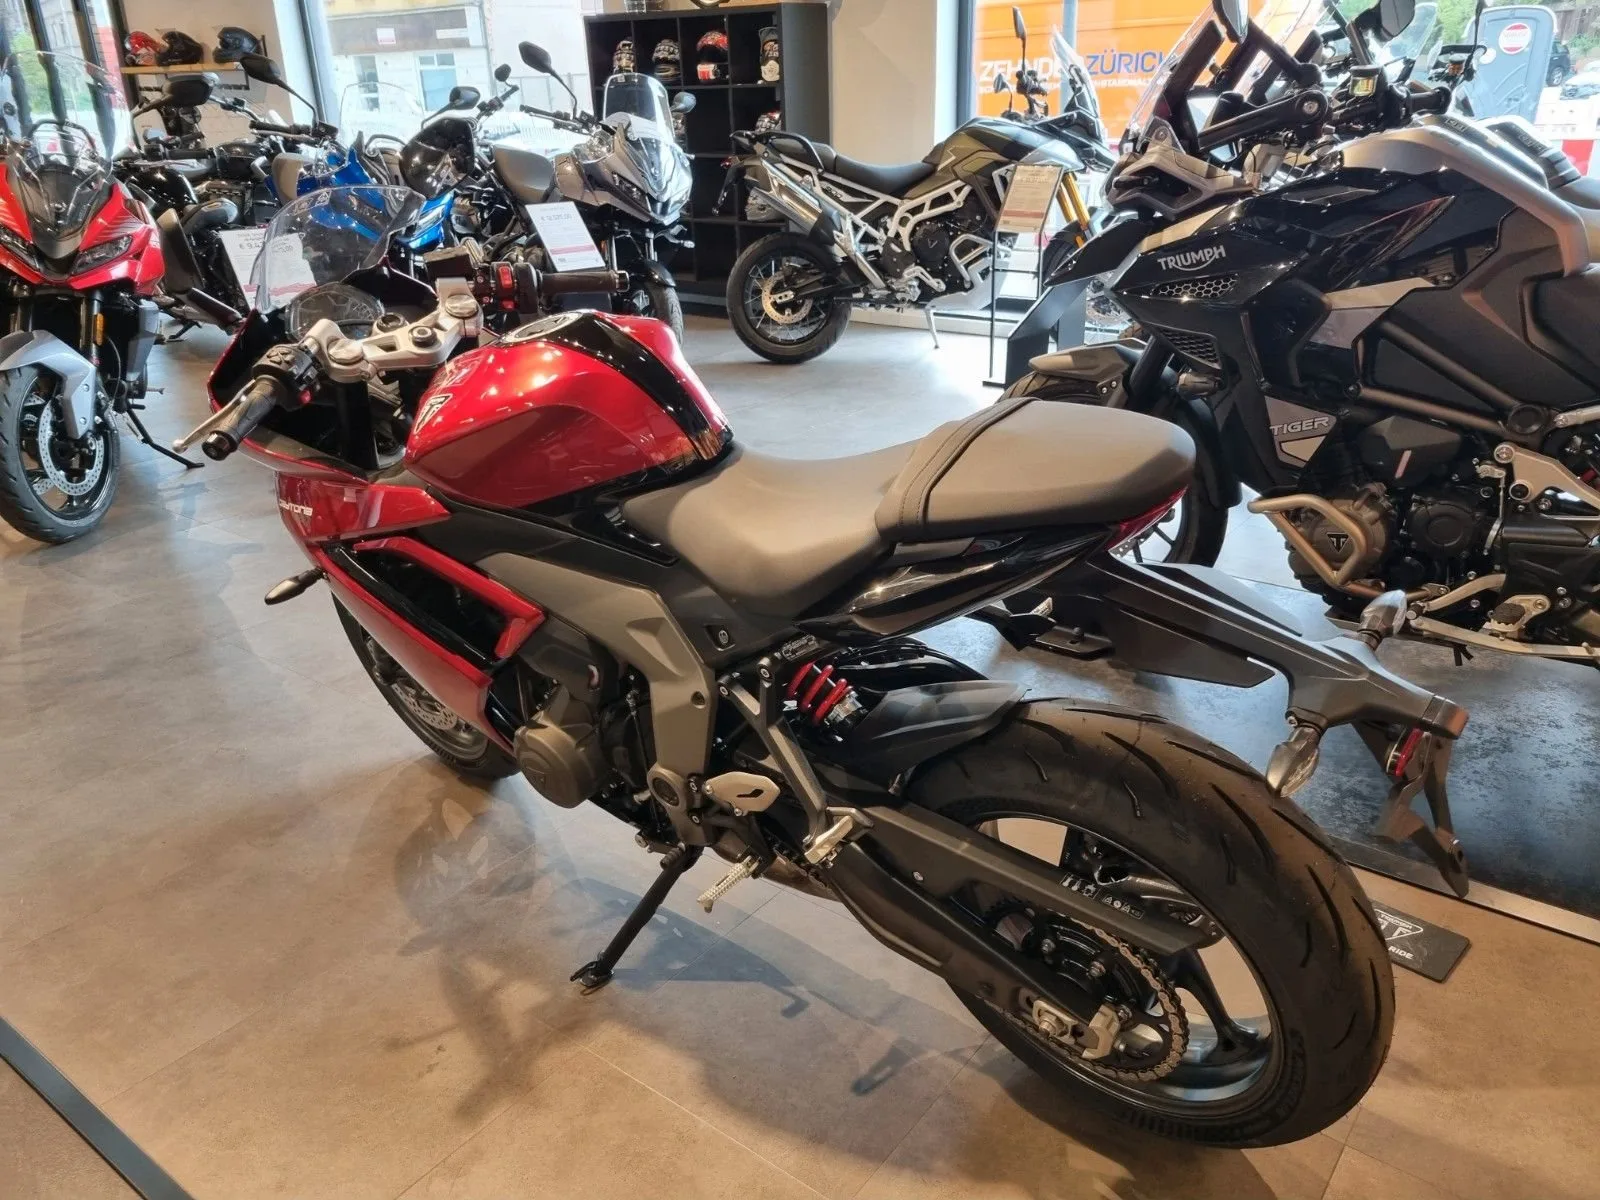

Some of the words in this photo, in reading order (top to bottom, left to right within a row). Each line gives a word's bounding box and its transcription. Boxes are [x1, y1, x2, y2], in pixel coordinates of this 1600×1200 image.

[1157, 245, 1227, 271] TRIUMPH
[1269, 416, 1329, 435] TIGER
[1387, 945, 1415, 960] RIDE
